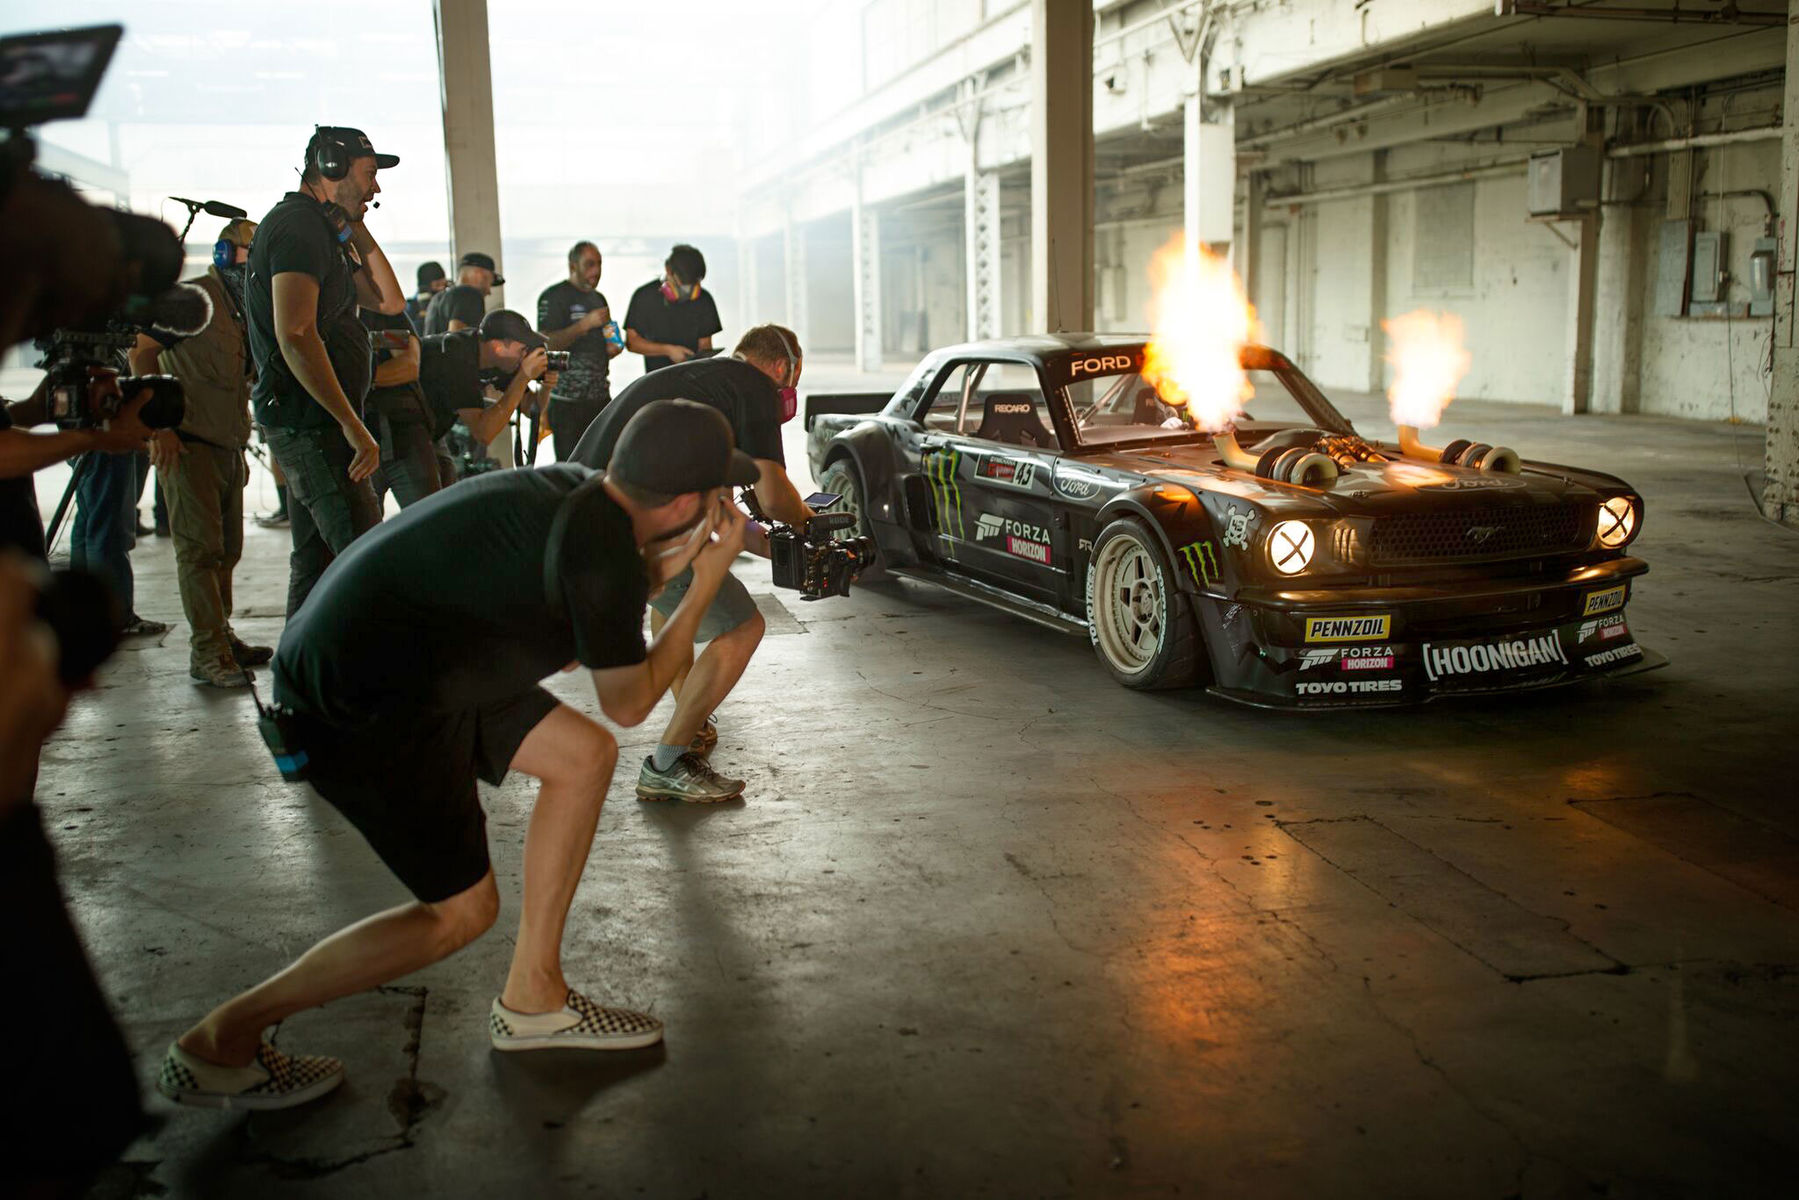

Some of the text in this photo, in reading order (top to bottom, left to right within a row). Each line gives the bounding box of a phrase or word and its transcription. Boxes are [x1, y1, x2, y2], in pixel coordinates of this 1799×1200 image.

[1070, 355, 1131, 377] FORD
[994, 404, 1031, 414] RECARO
[1060, 475, 1091, 496] Ford
[1005, 519, 1051, 545] FORZA
[1011, 538, 1047, 562] HORIZON
[1588, 590, 1623, 610] PENNZOIL
[1086, 605, 1099, 647] TOYO
[1310, 619, 1385, 638] PENNZOIL
[1598, 615, 1625, 628] FORZA
[1341, 646, 1394, 658] FORZA
[1584, 643, 1642, 668] TOYO TIRES
[1347, 657, 1388, 670] HORIZON
[1295, 679, 1402, 695] TOYO TIRES
